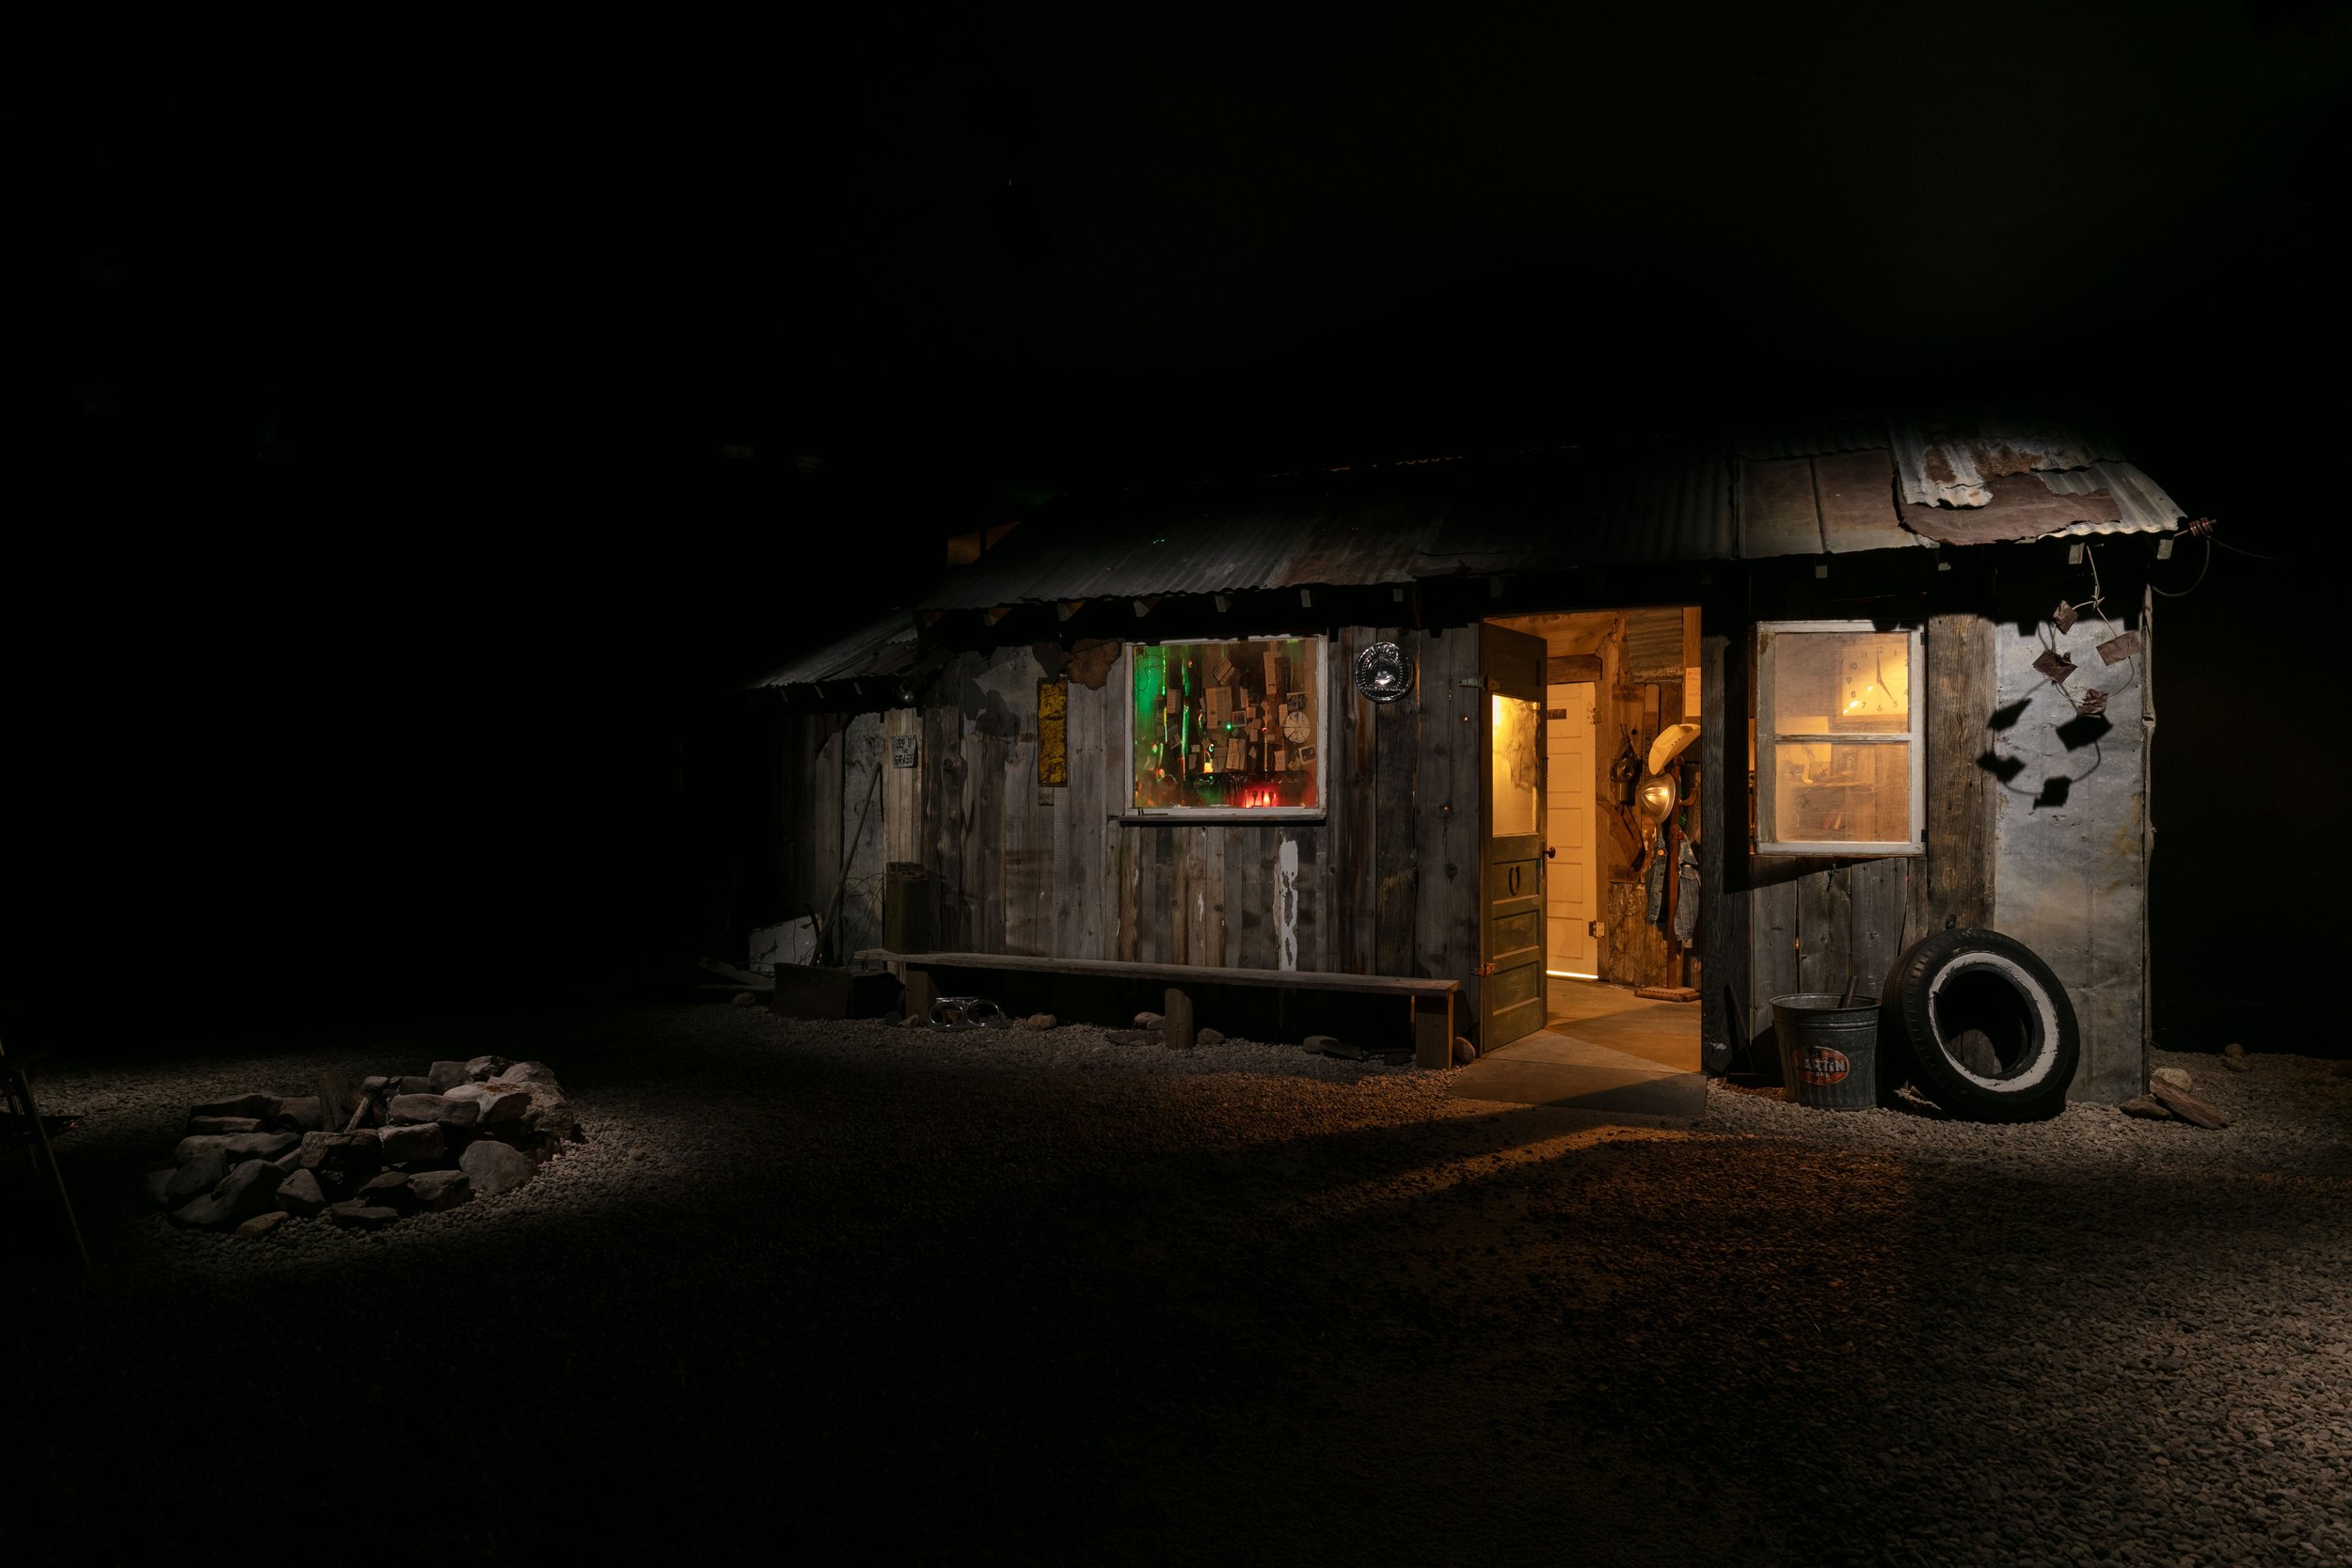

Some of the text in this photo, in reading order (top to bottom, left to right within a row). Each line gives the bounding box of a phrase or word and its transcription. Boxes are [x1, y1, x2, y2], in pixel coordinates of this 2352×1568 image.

[1846, 676, 1852, 685] 9
[1851, 690, 1856, 699] 8
[1861, 701, 1867, 709] 7
[1893, 700, 1899, 708] 5
[895, 753, 914, 765] GRASS
